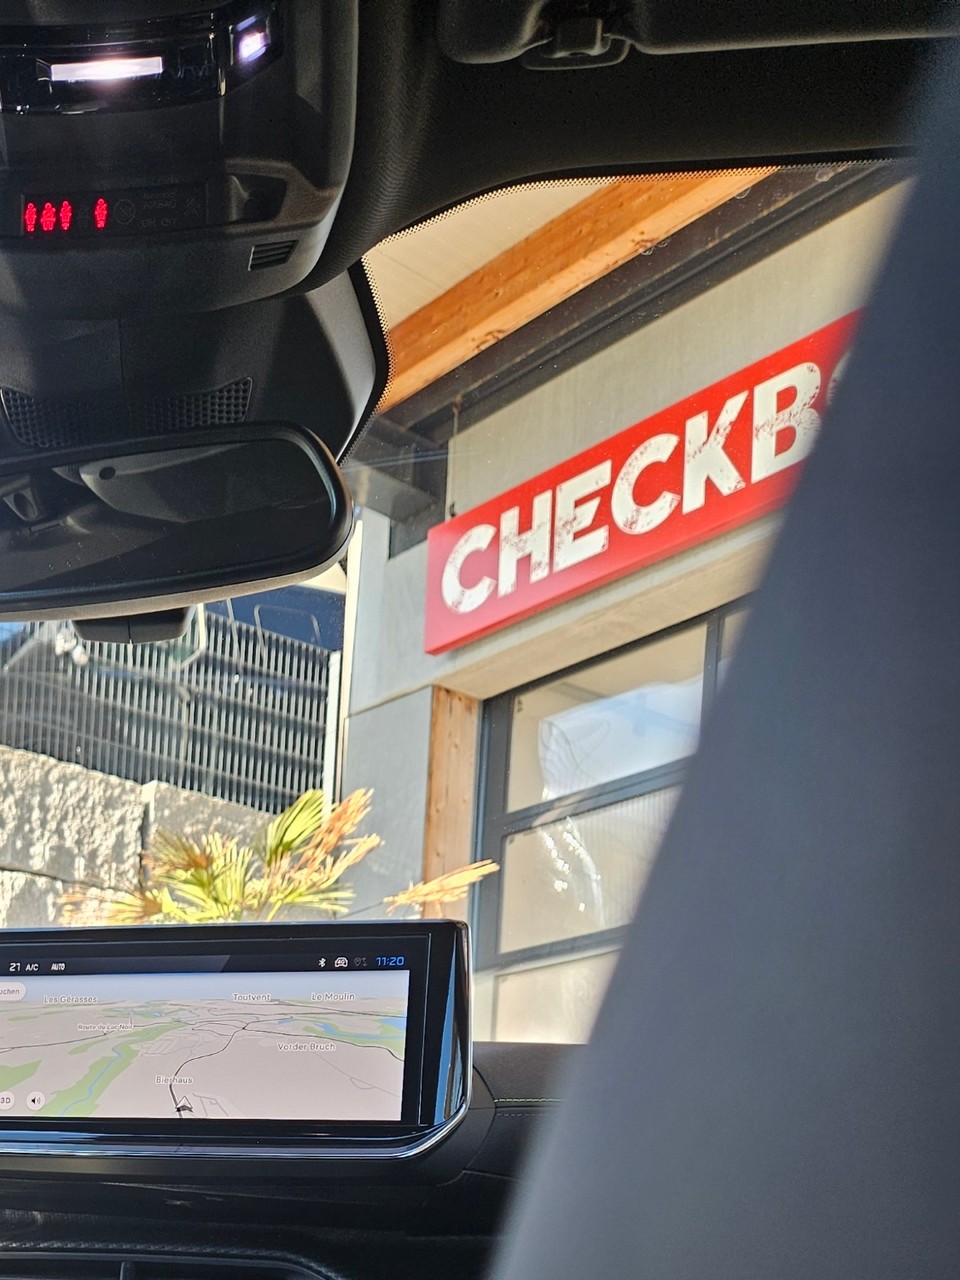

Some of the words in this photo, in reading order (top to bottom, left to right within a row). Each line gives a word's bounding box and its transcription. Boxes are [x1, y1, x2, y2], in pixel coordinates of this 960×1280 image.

[441, 350, 851, 615] CHECKB
[25, 962, 39, 972] A/C
[50, 962, 66, 971] AUTO
[376, 956, 405, 966] 11:20
[44, 995, 58, 1003] Les
[233, 993, 271, 1001] Toutvent
[156, 1076, 192, 1084] Bierhaus
